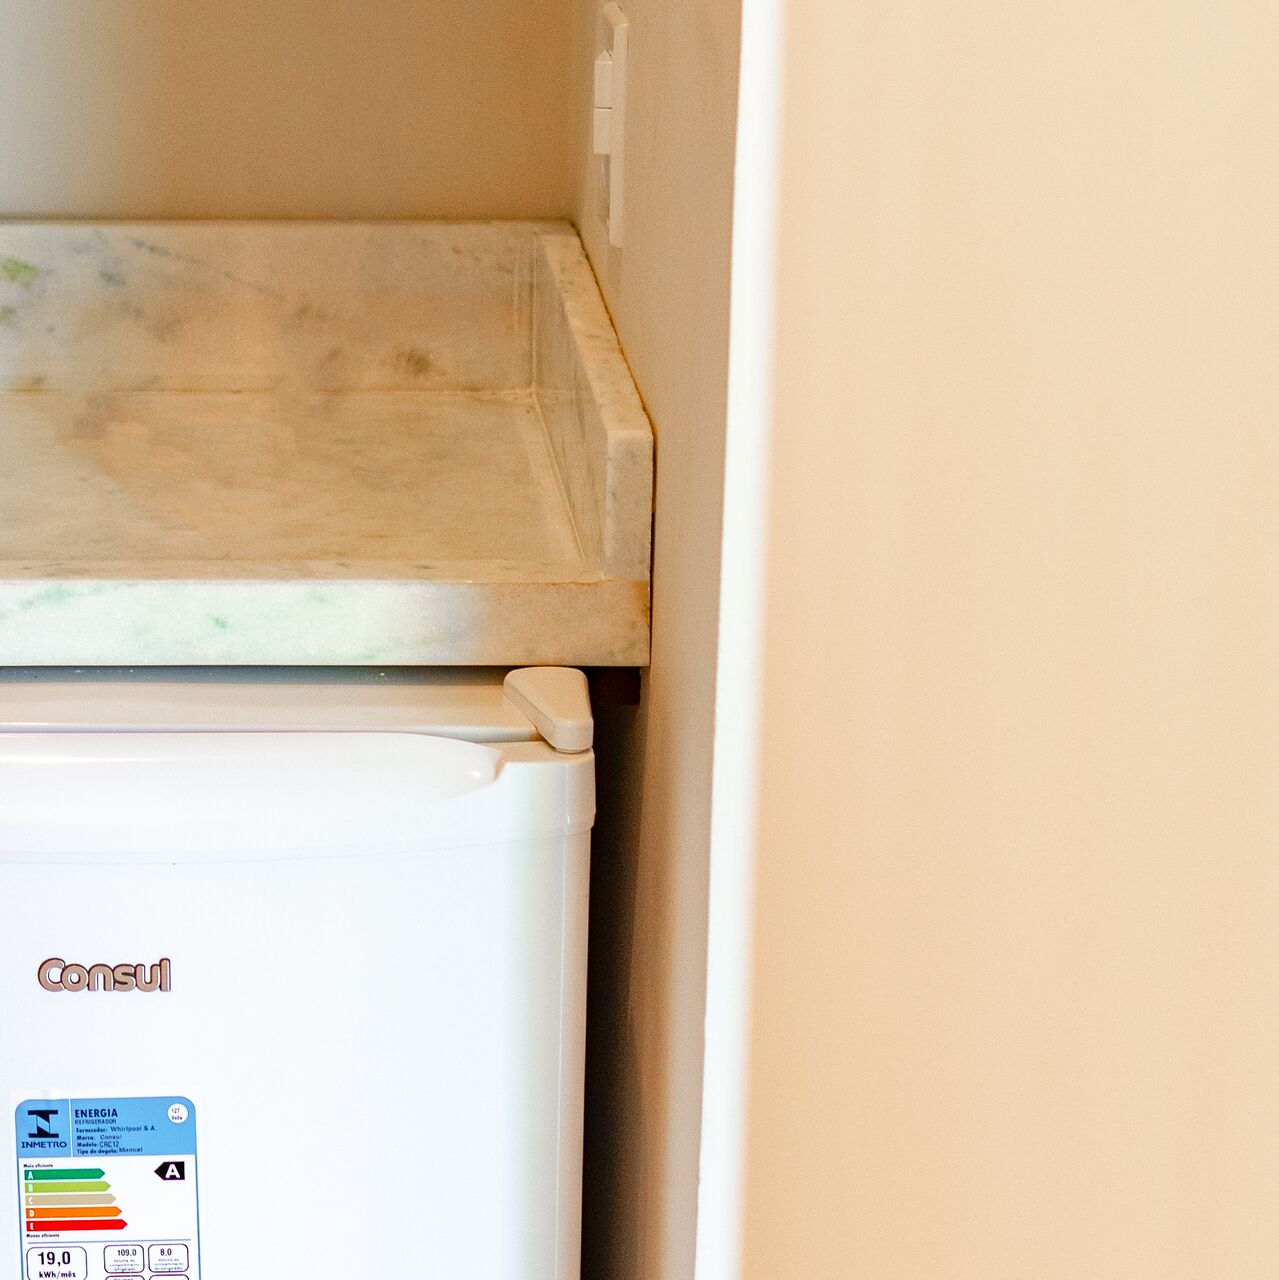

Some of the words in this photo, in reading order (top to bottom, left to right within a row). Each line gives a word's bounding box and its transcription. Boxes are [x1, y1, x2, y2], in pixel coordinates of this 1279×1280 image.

[37, 957, 172, 993] Consul
[75, 1108, 118, 1118] ENERGIA
[28, 1171, 34, 1180] A
[165, 1163, 181, 1179] A
[28, 1183, 34, 1192] B
[28, 1196, 33, 1205] C
[29, 1209, 35, 1218] D
[30, 1222, 35, 1230] E
[37, 1251, 71, 1267] 19,0
[39, 1271, 76, 1279] kWh/mês
